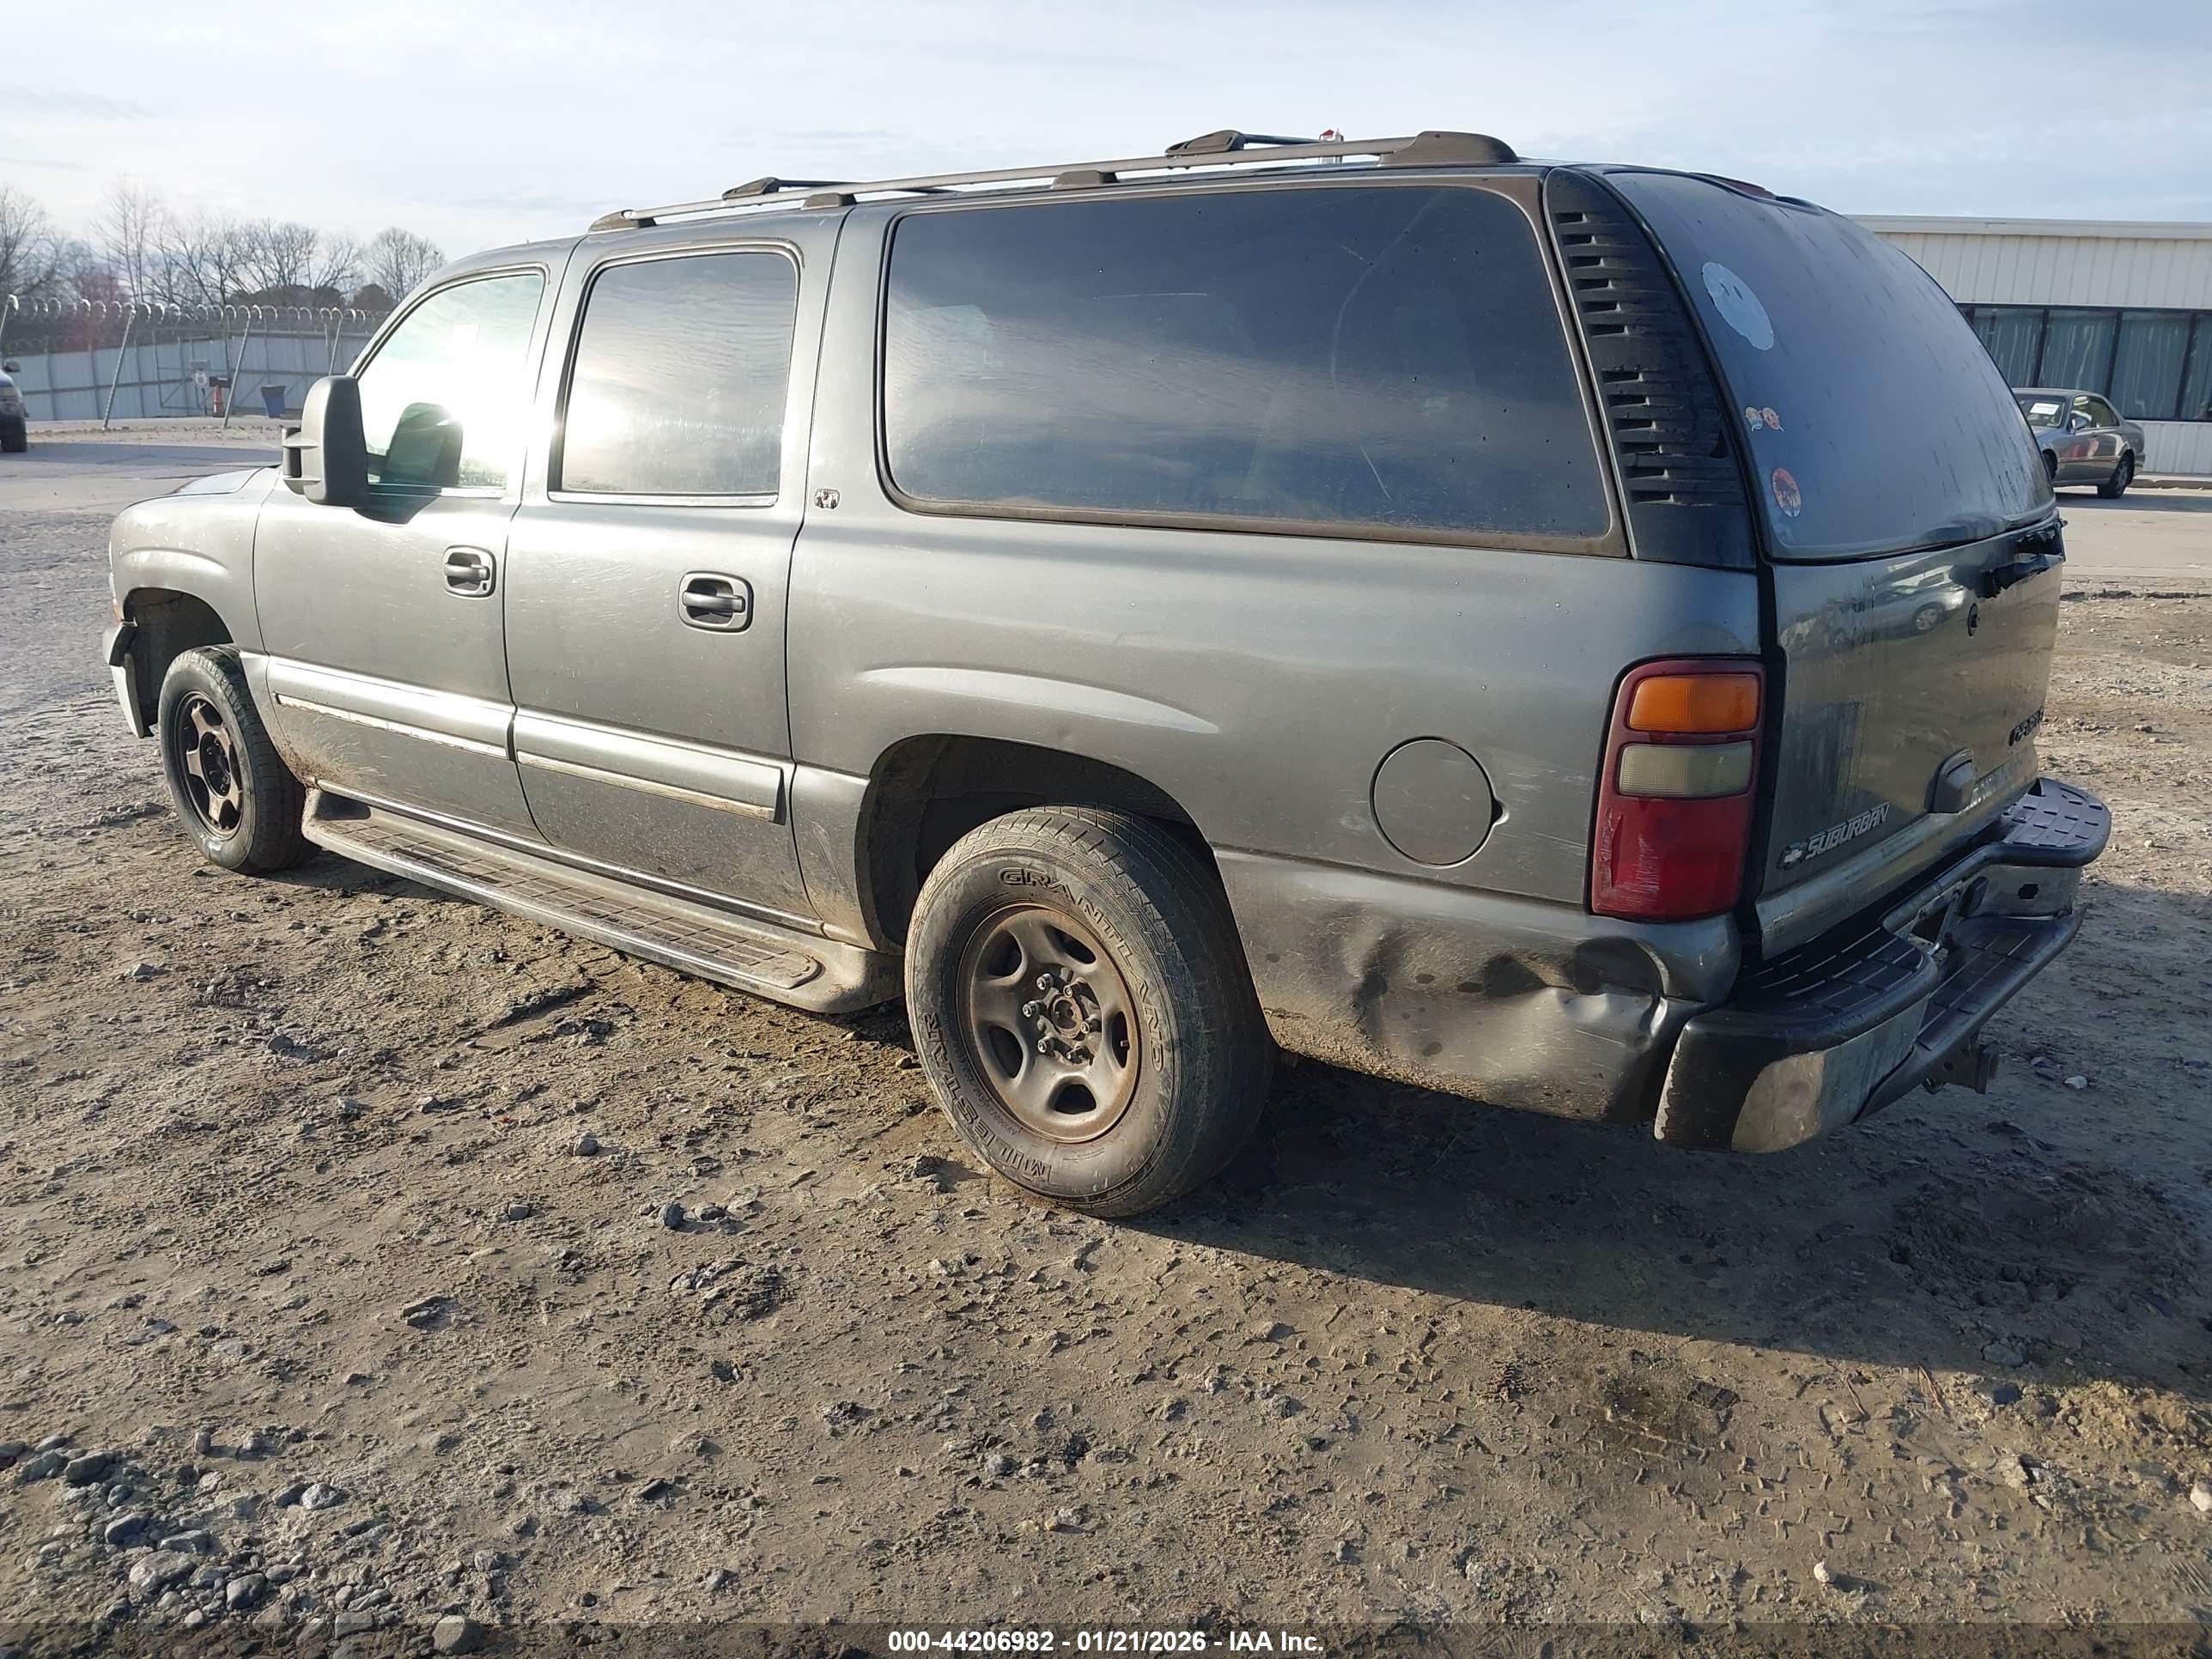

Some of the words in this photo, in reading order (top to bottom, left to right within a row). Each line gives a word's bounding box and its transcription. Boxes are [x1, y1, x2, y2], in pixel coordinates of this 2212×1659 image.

[1805, 801, 1889, 860] SUBURBAN
[1000, 866, 1164, 1073] GRANTLAND
[923, 1012, 1052, 1182] MILESTAR
